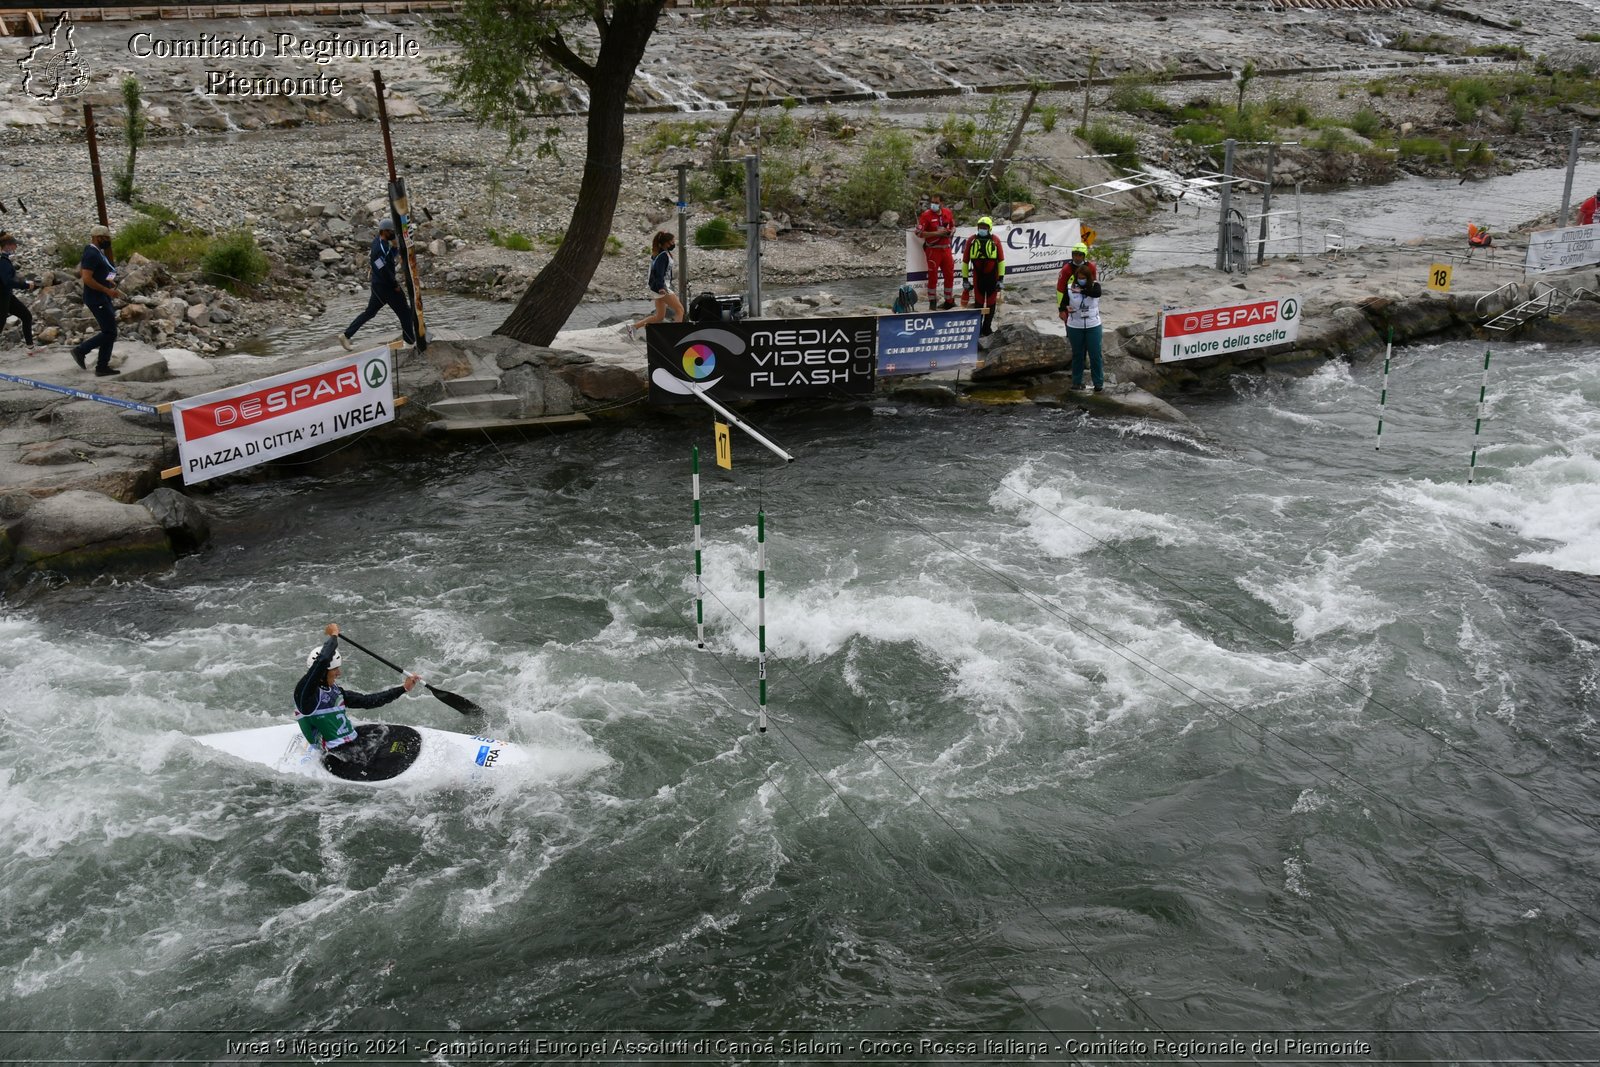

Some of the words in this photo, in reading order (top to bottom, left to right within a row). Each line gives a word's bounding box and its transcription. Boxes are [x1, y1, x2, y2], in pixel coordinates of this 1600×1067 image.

[1433, 269, 1447, 287] 18
[904, 318, 935, 331] ECA
[944, 318, 978, 327] CANOE
[1184, 305, 1278, 331] DESPAR
[750, 329, 850, 347] MEDIA
[920, 335, 972, 344] EUROPEAN
[936, 326, 975, 335] SLALOM
[886, 342, 969, 355] CHAMPIONSHIPS
[1184, 340, 1219, 355] valore
[1222, 334, 1250, 349] della
[1253, 329, 1287, 344] scelta
[750, 349, 850, 366] VIDEO
[750, 369, 849, 387] FLASH
[214, 371, 358, 427] DESPAR
[189, 447, 242, 472] PIAZZA
[245, 440, 260, 456] DI
[310, 421, 324, 438] 21
[333, 401, 387, 432] IVREA
[718, 432, 727, 459] 17
[484, 749, 501, 768] FRA
